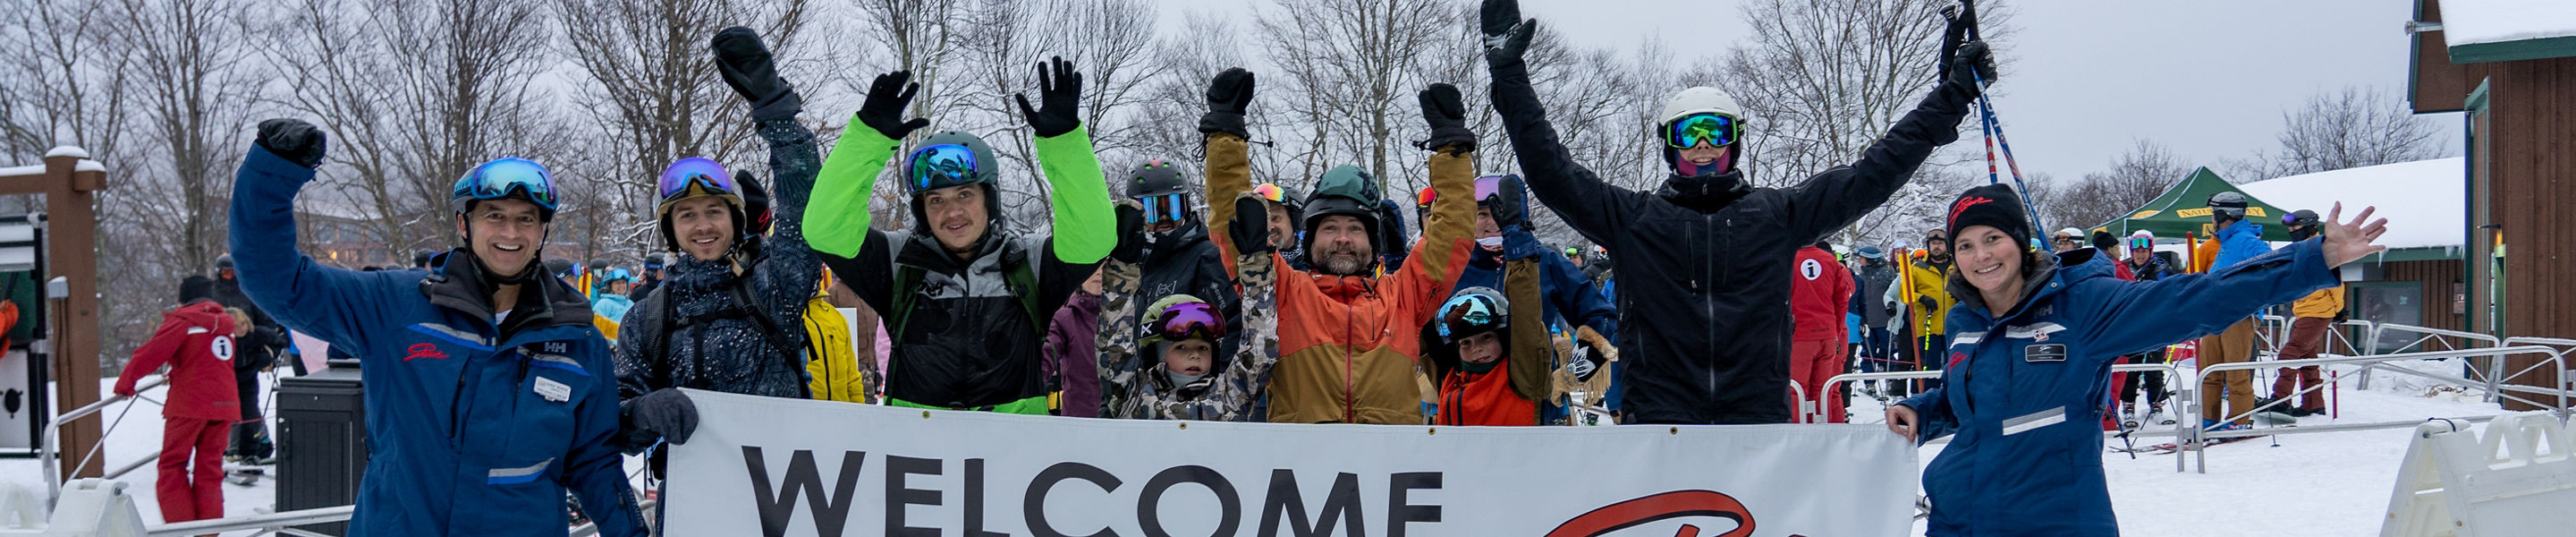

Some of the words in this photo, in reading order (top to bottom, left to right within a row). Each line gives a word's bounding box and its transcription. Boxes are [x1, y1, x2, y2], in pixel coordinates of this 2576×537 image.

[2181, 207, 2214, 218] NATU
[544, 341, 567, 354] HH
[741, 444, 1443, 537] WELCOME
